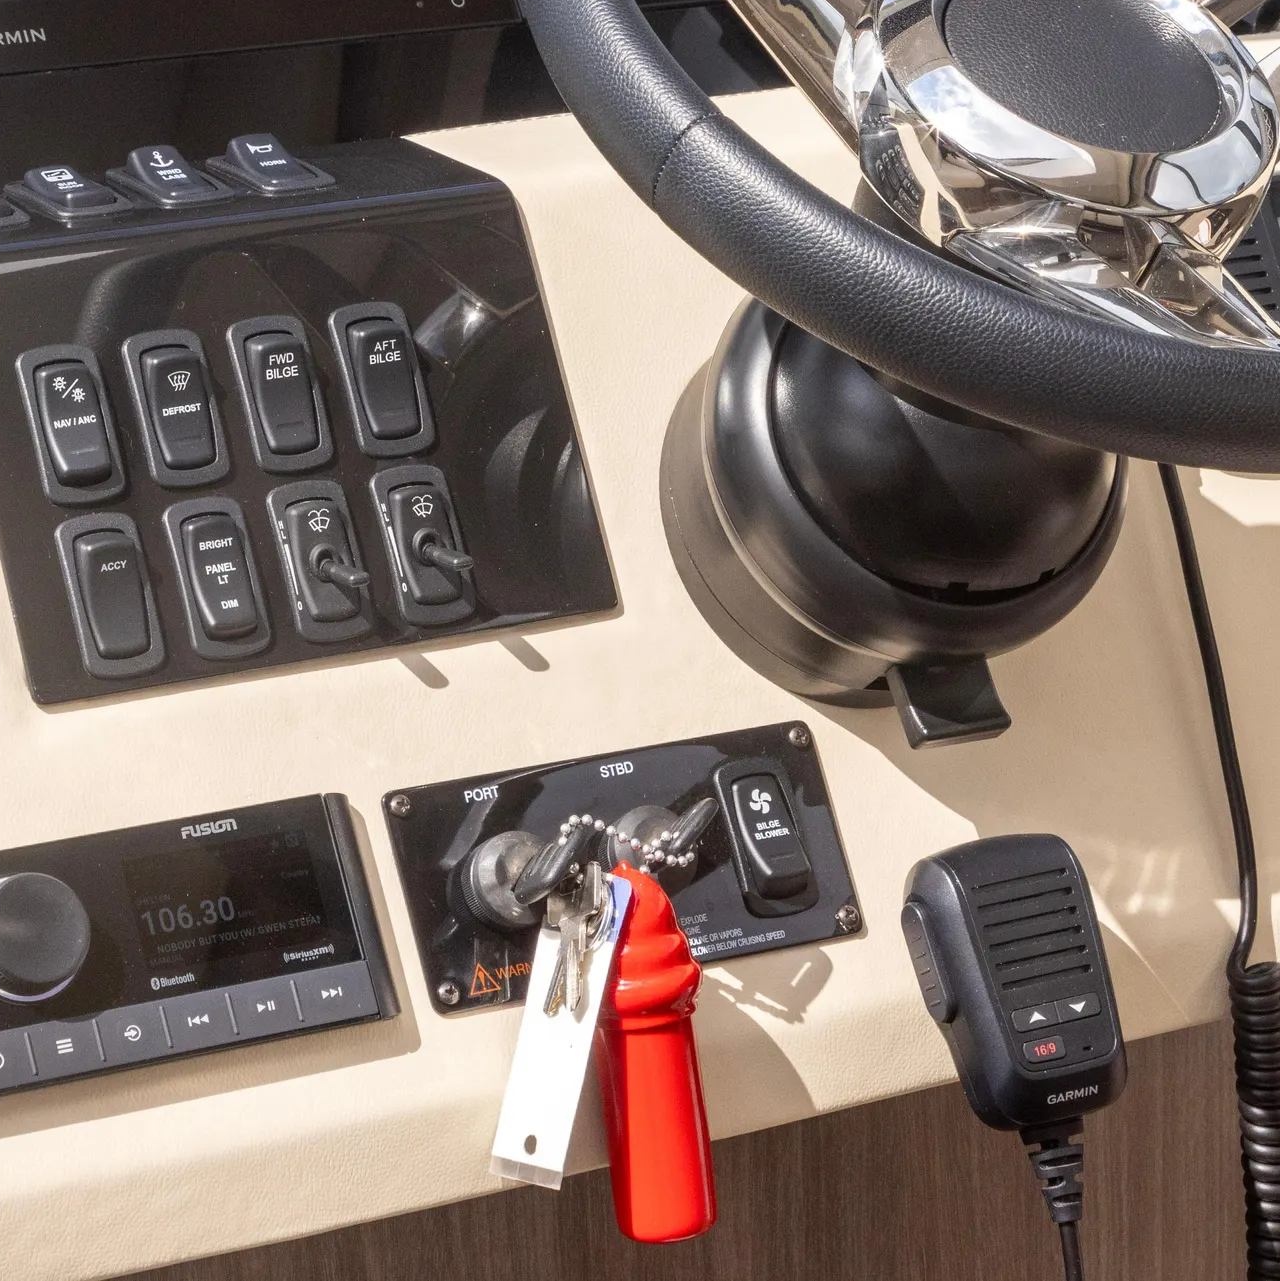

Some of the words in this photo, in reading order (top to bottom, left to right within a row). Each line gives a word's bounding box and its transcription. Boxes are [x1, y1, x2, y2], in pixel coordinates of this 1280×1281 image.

[259, 159, 287, 168] HORN
[157, 168, 183, 176] WIND
[162, 173, 188, 181] LASS
[374, 339, 397, 352] AFT
[269, 352, 294, 366] FWD
[369, 350, 402, 365] BILGE
[266, 365, 299, 380] BILGE
[162, 403, 202, 416] DEFROST
[53, 417, 72, 429] NAV
[77, 414, 97, 425] ANC
[199, 537, 233, 551] BRIGHT
[100, 560, 127, 572] ACCY
[205, 562, 236, 575] PANEL
[218, 574, 229, 585] LT
[220, 599, 239, 610] DIM
[600, 761, 634, 779] STBD
[463, 785, 499, 803] PORT
[180, 818, 238, 840] FUSION
[755, 819, 782, 831] BILGE
[754, 828, 790, 841] BLOWER
[140, 896, 236, 936] 106.30
[680, 913, 708, 926] EXPLODE
[157, 938, 197, 954] NOBODY
[198, 934, 217, 946] BUT
[218, 930, 238, 942] YOU
[257, 921, 287, 935] GWEN
[709, 932, 719, 942] OR
[719, 928, 743, 939] VAPORS
[716, 939, 738, 951] BELOW
[738, 934, 765, 947] CRUISING
[766, 930, 786, 941] SPEED
[159, 972, 195, 987] Bluetooth
[1034, 1042, 1057, 1056] 16/9
[1046, 1084, 1099, 1105] GARMIN
